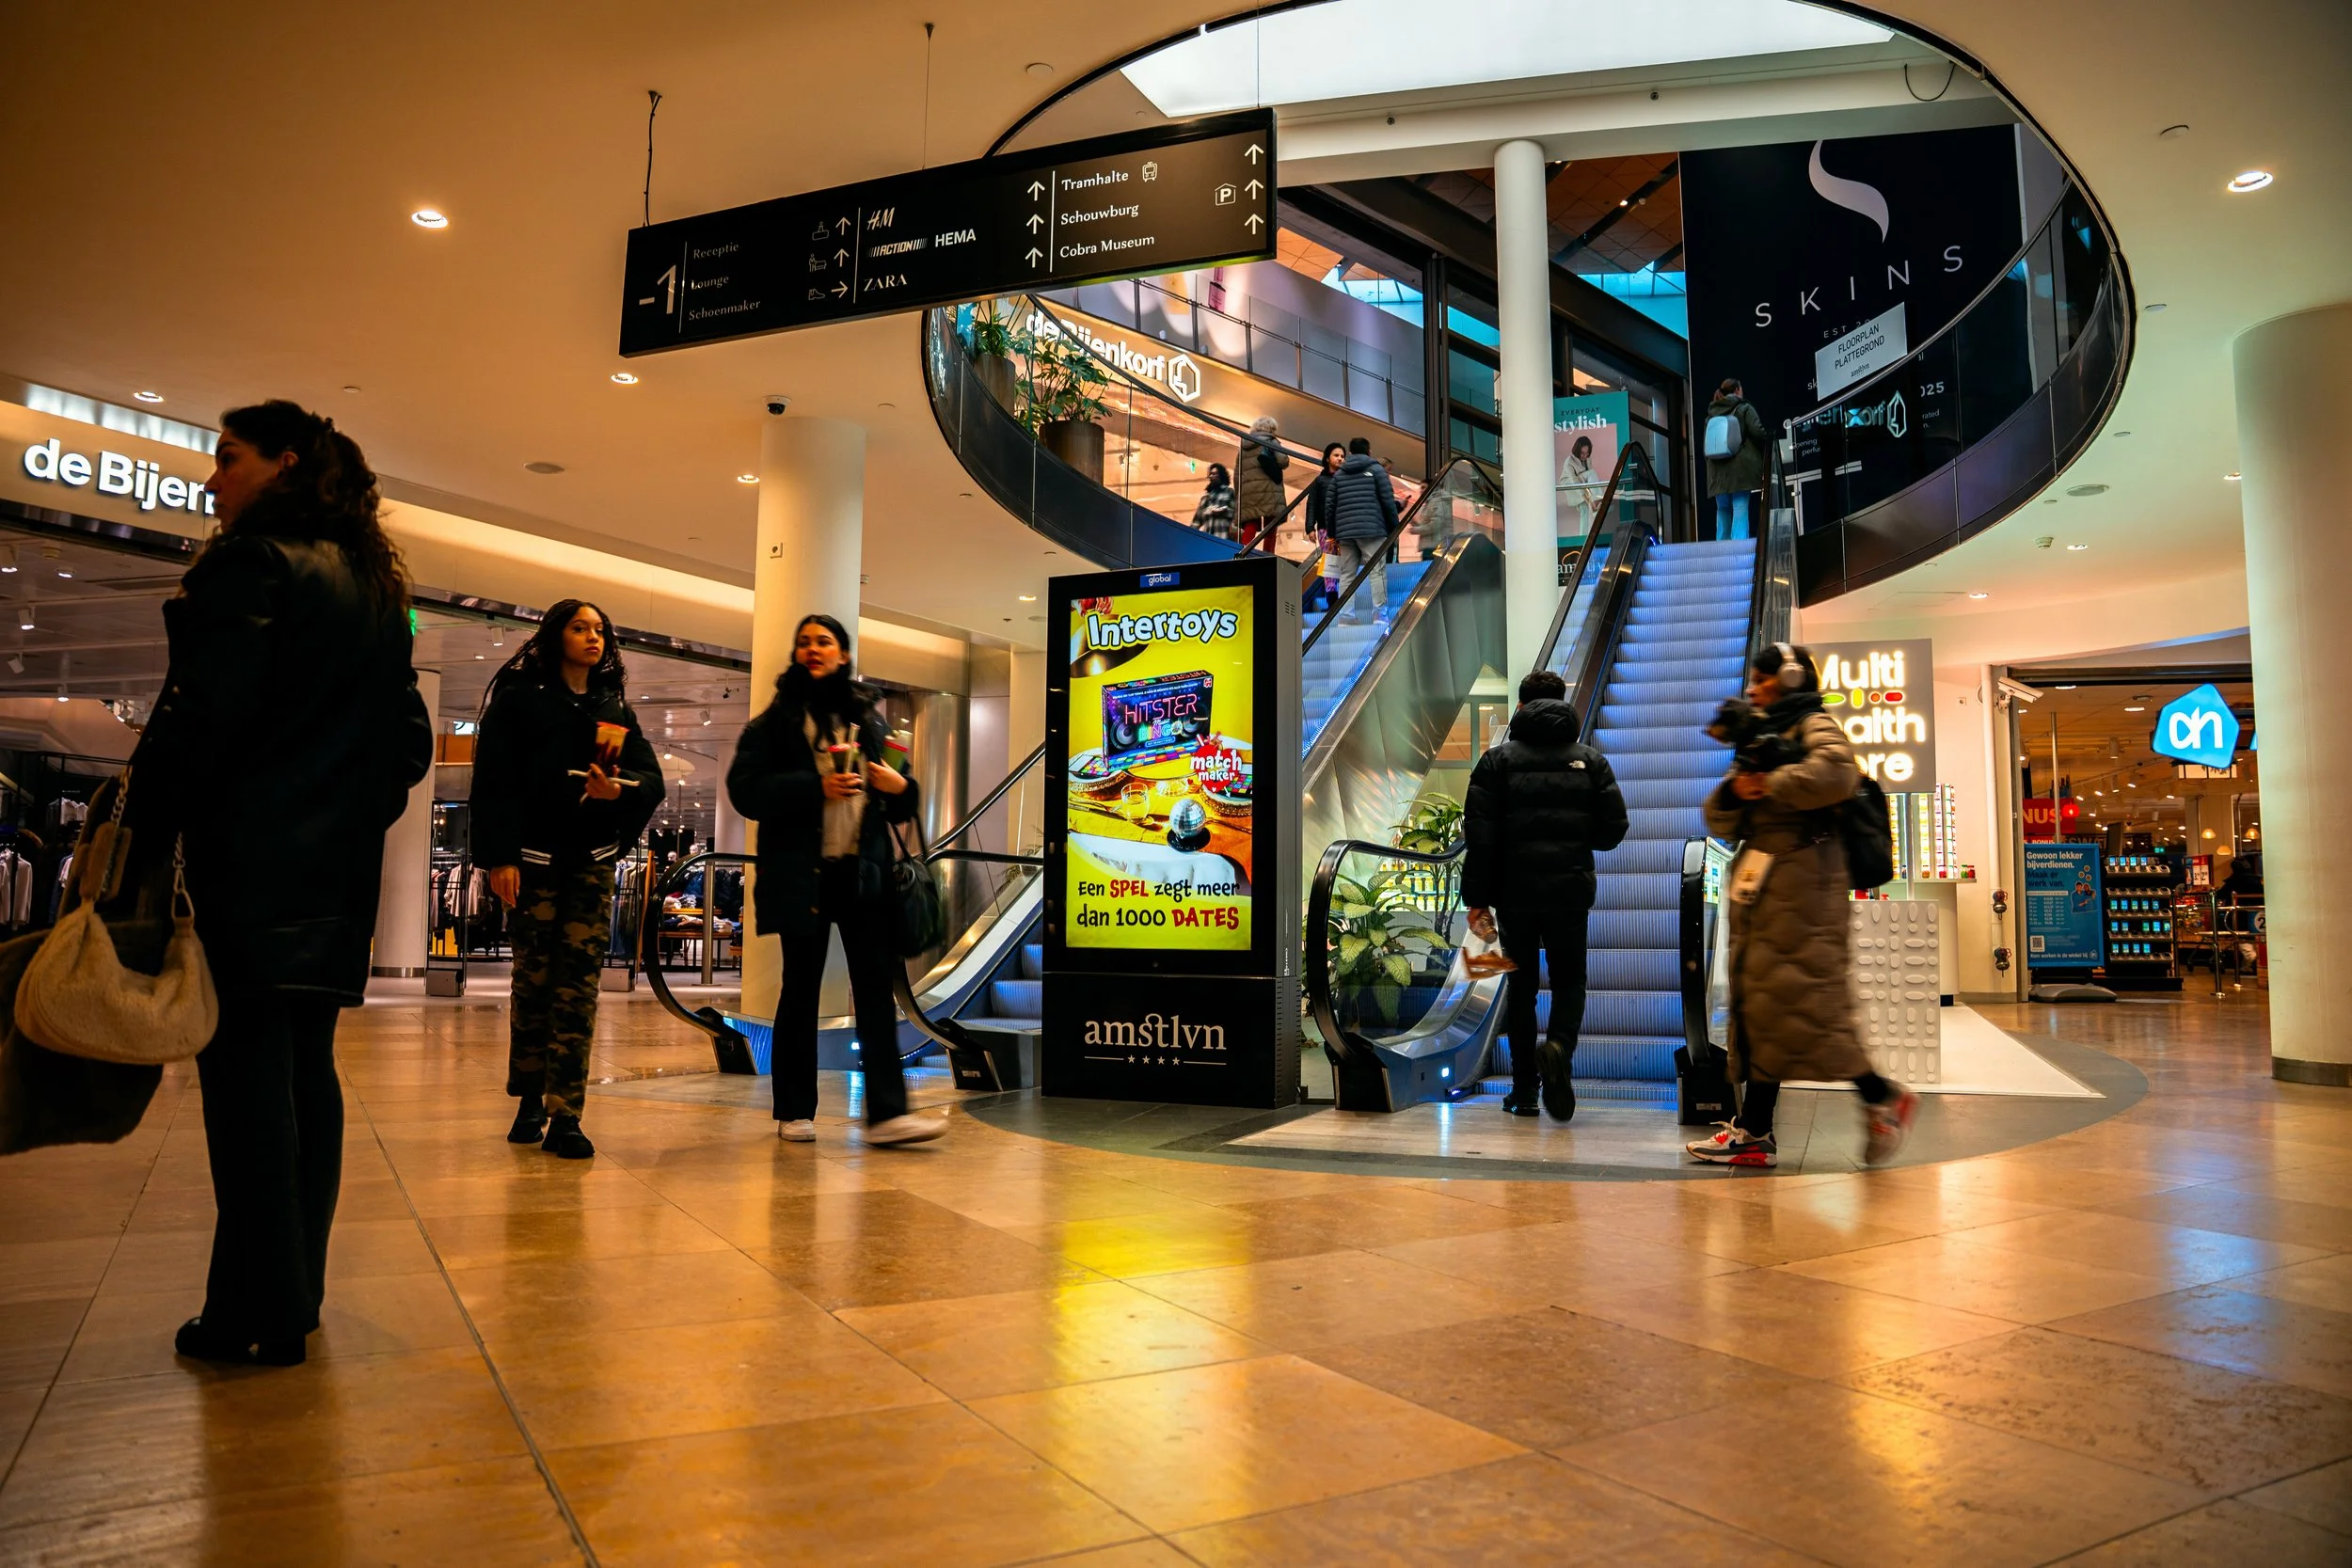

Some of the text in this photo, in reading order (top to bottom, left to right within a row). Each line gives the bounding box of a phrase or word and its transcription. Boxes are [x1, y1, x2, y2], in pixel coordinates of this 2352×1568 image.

[1061, 170, 1129, 190] Tramhalte
[1220, 187, 1232, 203] P
[866, 206, 896, 231] H&M
[1060, 204, 1139, 225] Schouwburg
[879, 240, 914, 257] ACTION
[934, 228, 977, 248] HEMA
[1059, 235, 1155, 259] Cobra Museum
[692, 242, 739, 260] Receptie
[691, 276, 730, 291] Lounge
[864, 273, 908, 293] ZARA
[1756, 245, 1963, 327] SKINS
[689, 299, 761, 321] Schoenmaker
[1823, 325, 1848, 339] EST
[1837, 323, 1880, 355] FLOORPLAN
[1835, 335, 1885, 370] PLATTEGROND
[1561, 406, 1600, 417] EVERYDAY
[1554, 413, 1607, 435] stylish
[24, 438, 215, 515] de Bijen
[1148, 574, 1172, 587] global
[1087, 609, 1239, 647] Intertoys
[1124, 693, 1198, 725] HITSTER
[1138, 721, 1184, 743] BINGO
[1189, 749, 1243, 771] match
[1198, 770, 1235, 782] maker
[2026, 850, 2083, 860] Gewoon lekker
[2026, 860, 2075, 870] bijverdienen.
[2026, 870, 2049, 879] Maak
[1078, 879, 1240, 903] Een SPEL zegt meer
[1076, 903, 1240, 930] dan 1000 DATES
[1084, 1013, 1227, 1051] amstlvn
